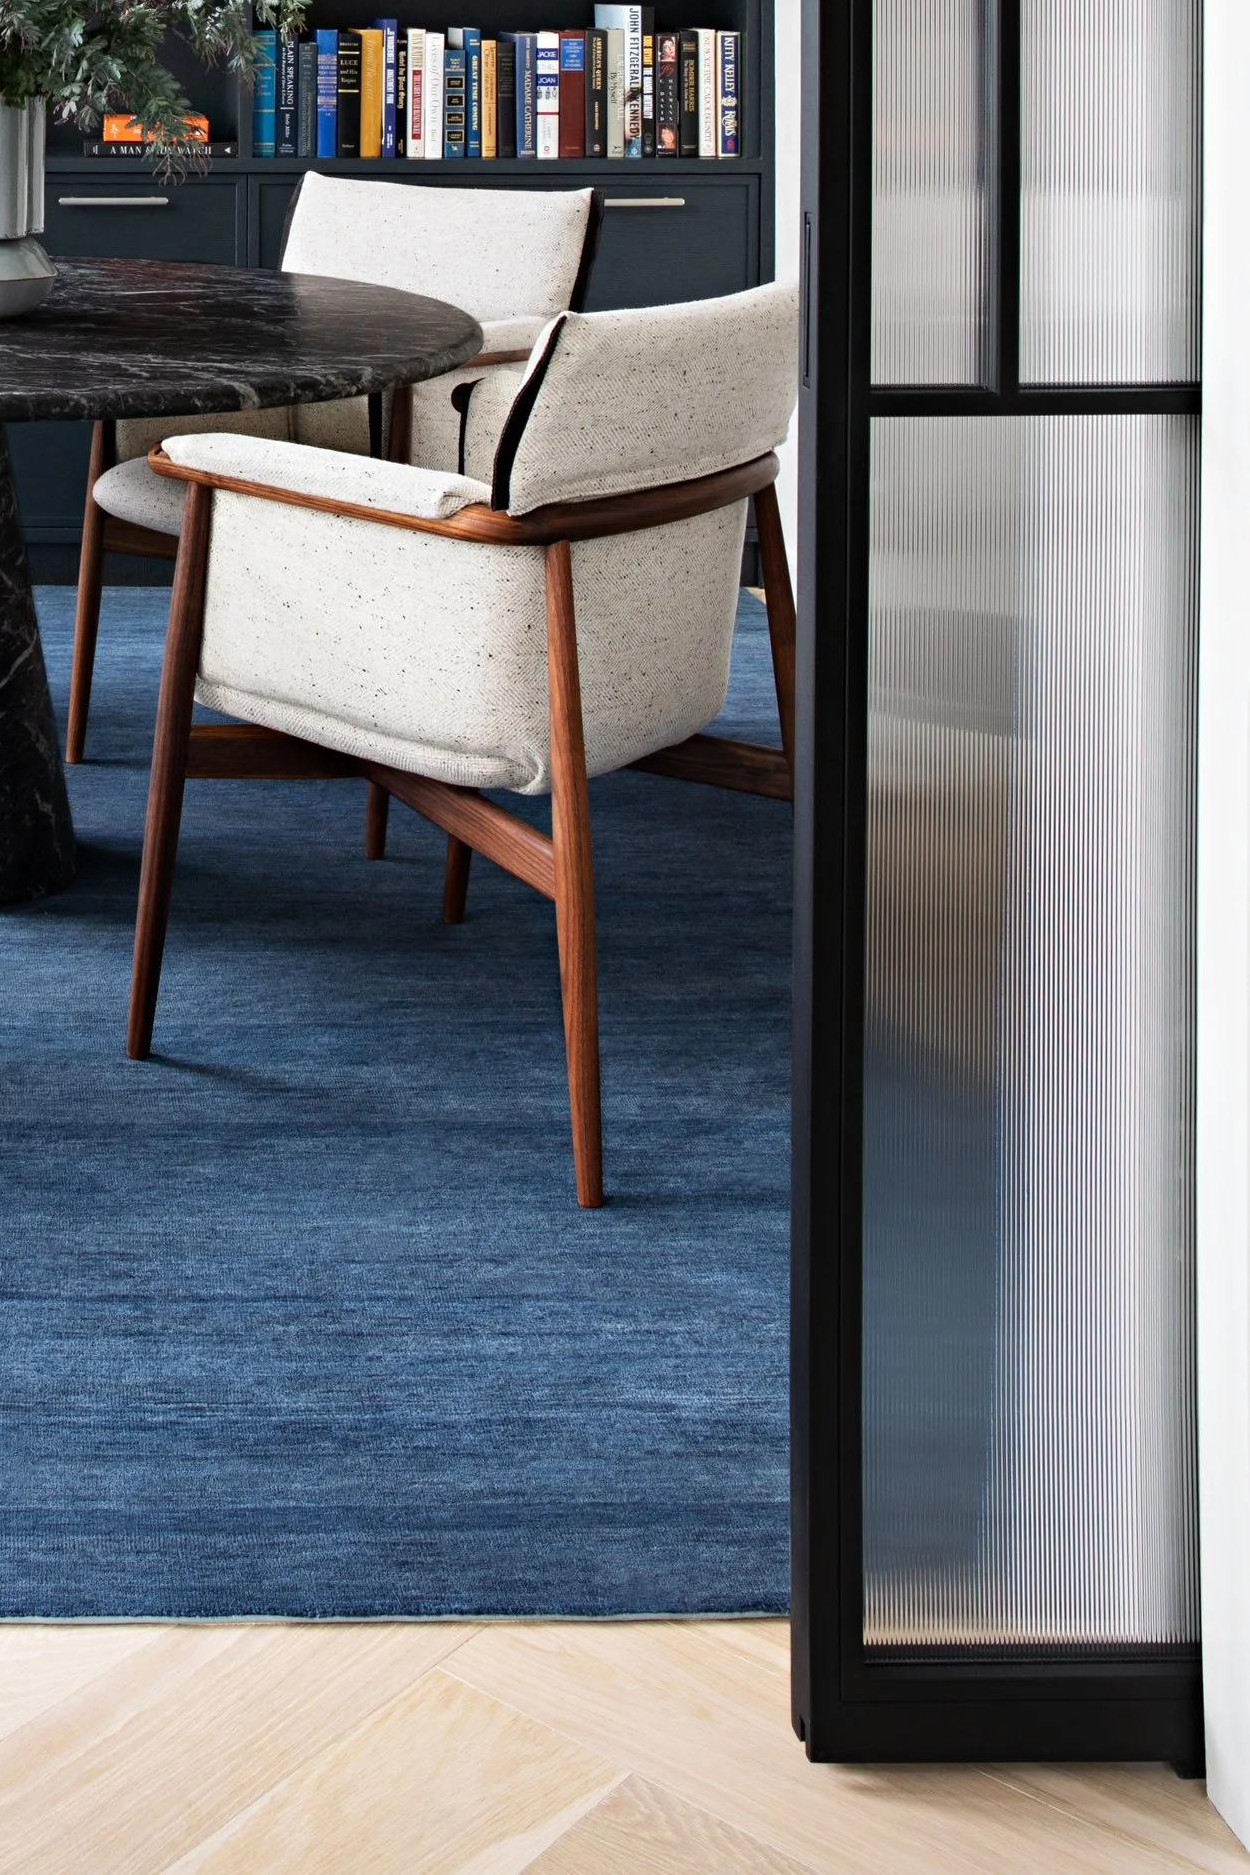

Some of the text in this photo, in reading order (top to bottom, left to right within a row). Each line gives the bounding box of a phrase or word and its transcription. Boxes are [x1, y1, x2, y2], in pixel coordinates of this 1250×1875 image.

[630, 8, 639, 140] JOHN FITZGERALD KENNEDY
[724, 37, 735, 92] KITTY KELLEY
[110, 146, 141, 154] A MAN
